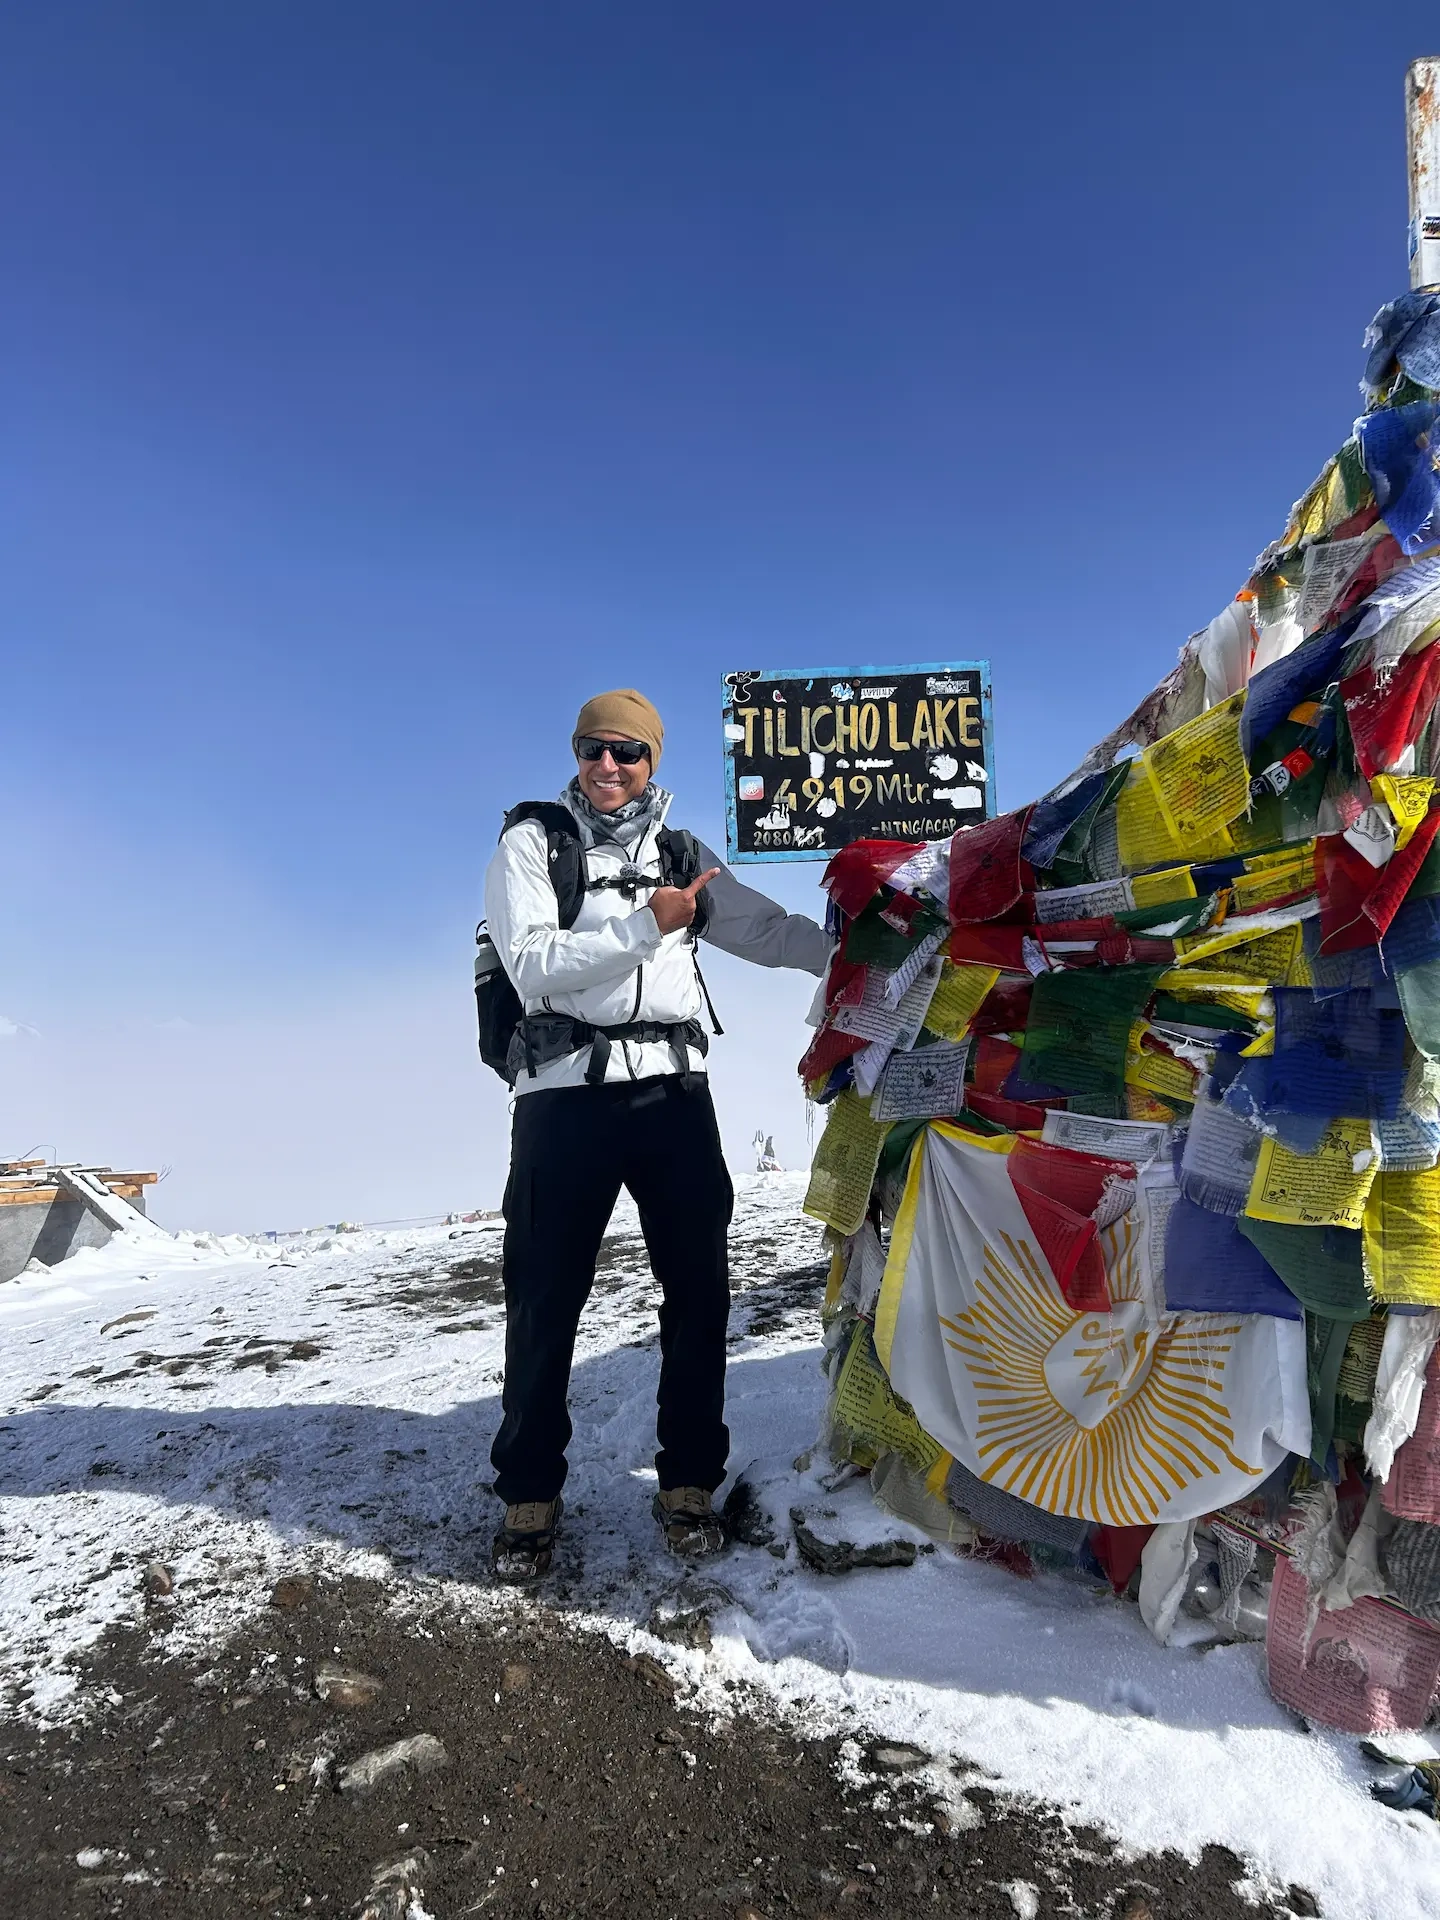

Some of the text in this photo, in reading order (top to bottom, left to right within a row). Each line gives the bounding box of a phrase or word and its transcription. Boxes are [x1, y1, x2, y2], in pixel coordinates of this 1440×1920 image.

[738, 697, 982, 758] TILICHO LAKE
[773, 773, 931, 813] 4919 Mtr.
